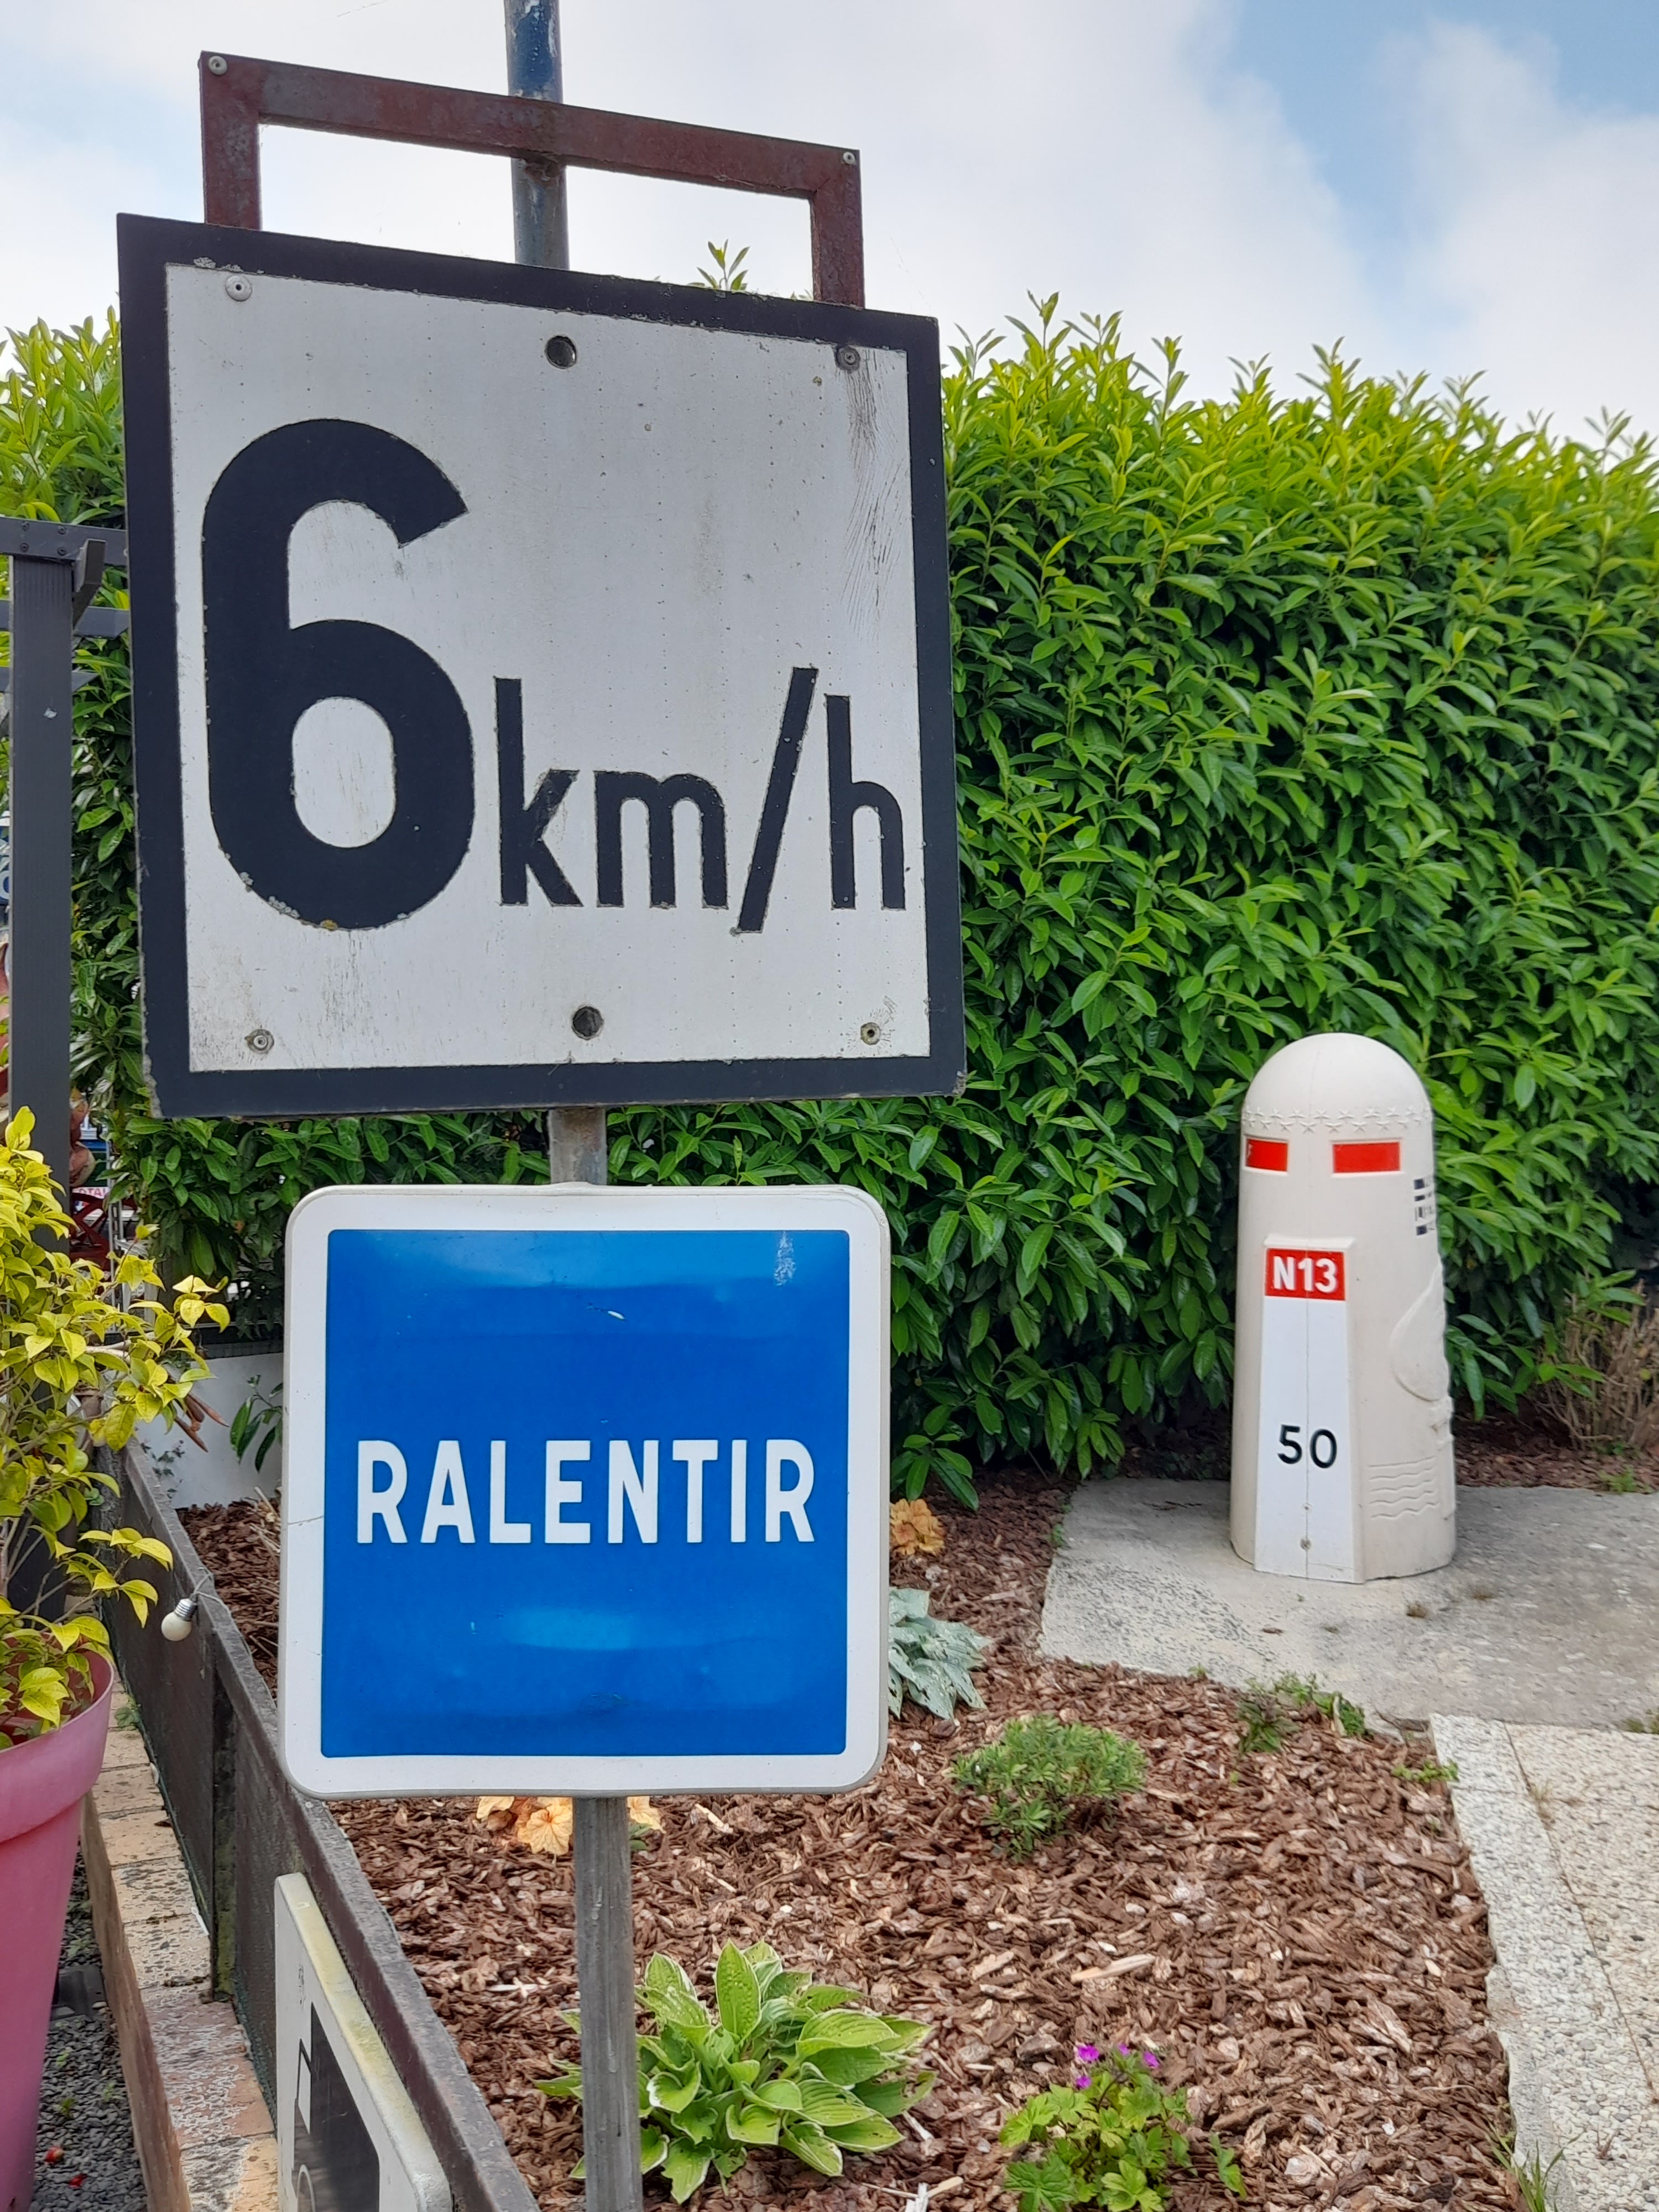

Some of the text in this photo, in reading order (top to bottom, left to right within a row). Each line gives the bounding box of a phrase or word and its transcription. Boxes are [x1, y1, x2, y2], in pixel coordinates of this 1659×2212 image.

[1273, 1256, 1337, 1293] N13
[1278, 1425, 1337, 1469] 50
[357, 1439, 815, 1543] RALENTIR
